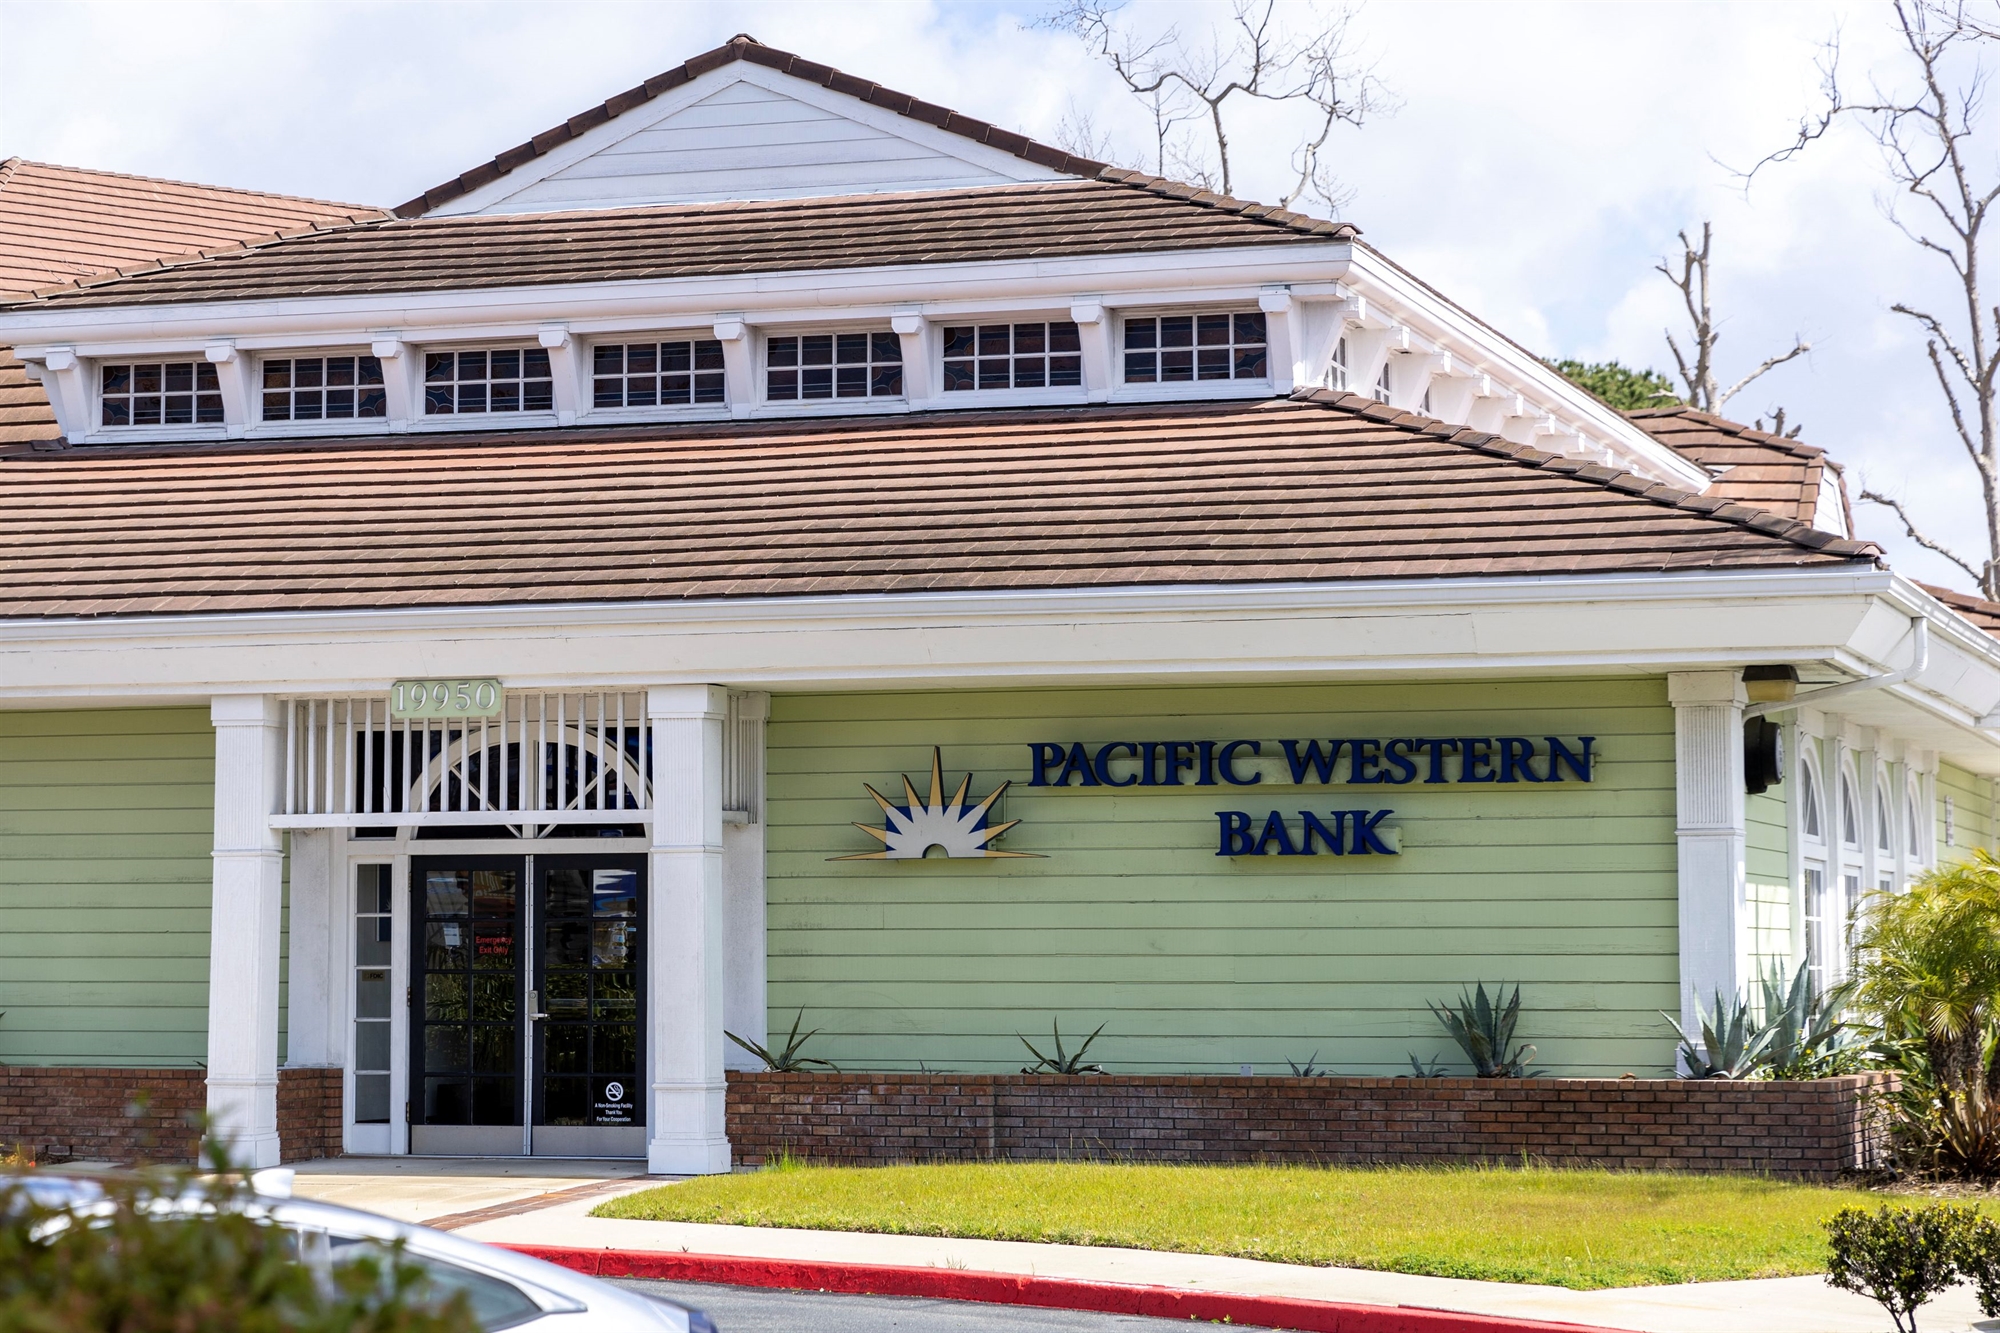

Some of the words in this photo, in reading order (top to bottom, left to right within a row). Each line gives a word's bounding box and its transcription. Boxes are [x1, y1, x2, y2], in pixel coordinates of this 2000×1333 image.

[396, 682, 496, 712] 19950
[1027, 740, 1262, 787] PACIFIC
[1278, 736, 1596, 785] WESTERN
[1215, 810, 1398, 856] BANK
[475, 936, 512, 945] Emergency
[479, 946, 492, 954] Exit
[493, 946, 508, 955] Only
